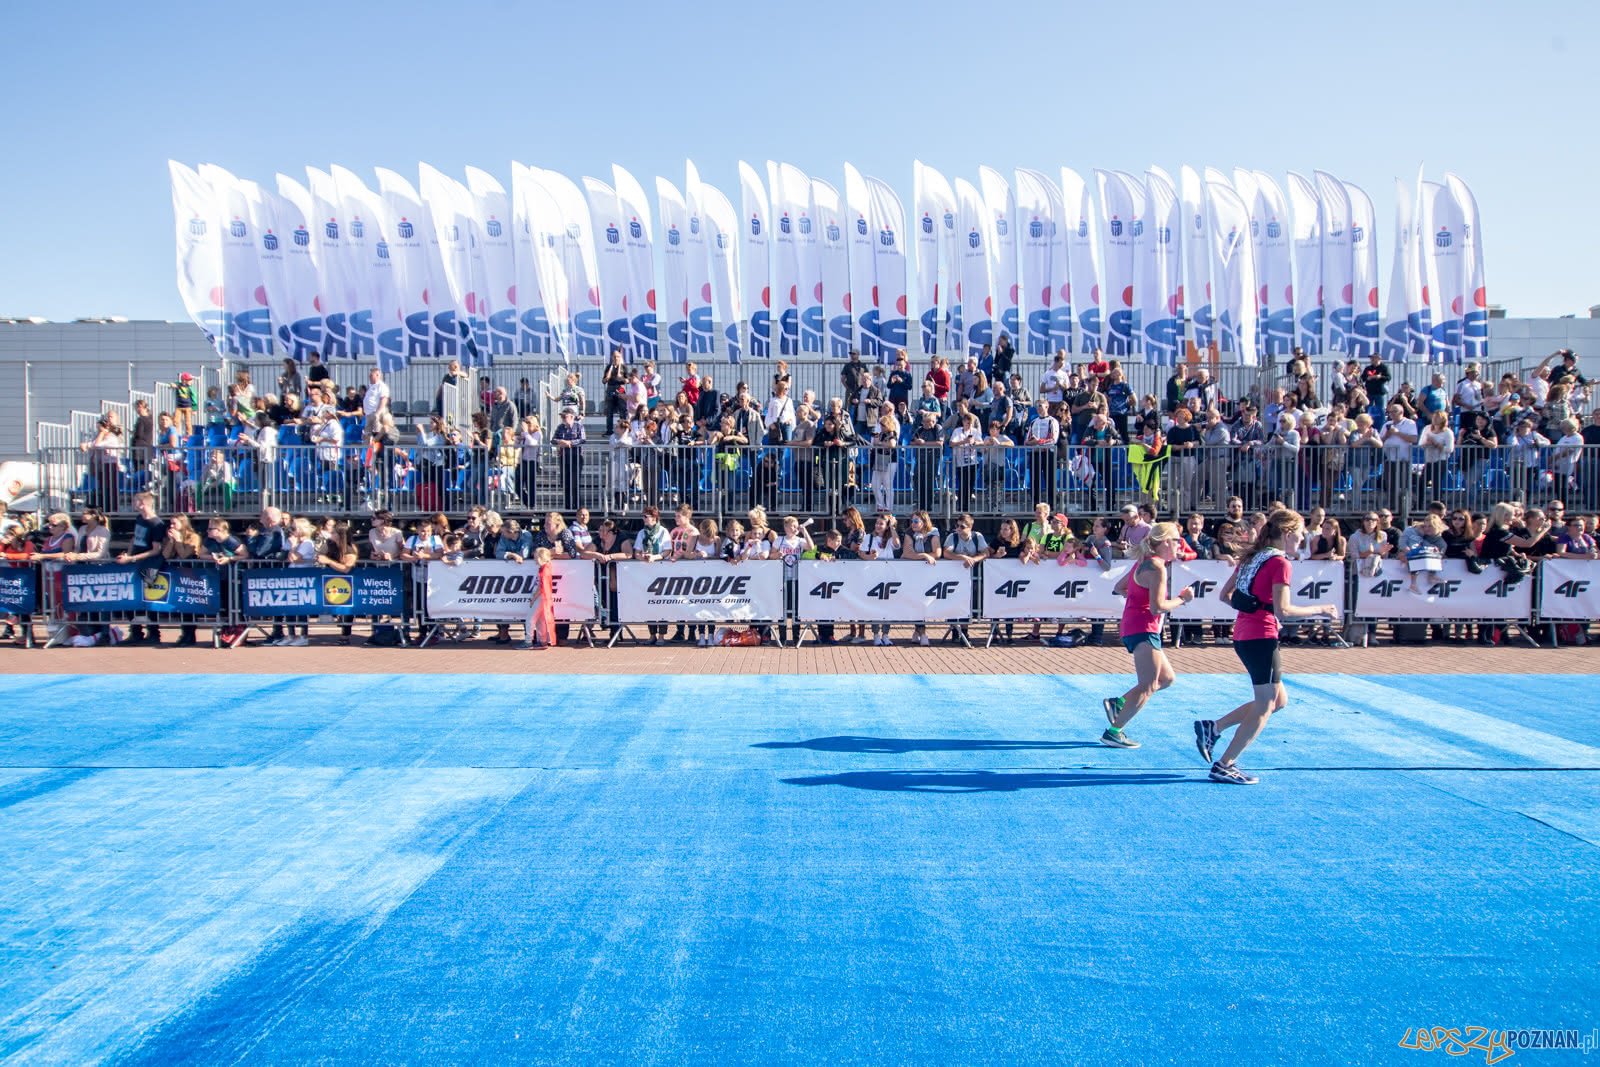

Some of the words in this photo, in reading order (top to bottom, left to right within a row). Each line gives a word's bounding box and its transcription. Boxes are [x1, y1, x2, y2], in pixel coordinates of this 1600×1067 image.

[67, 572, 135, 586] BIEGNIEMY
[180, 577, 207, 589] Więcej
[248, 577, 316, 590] BIEGNIEMY
[363, 578, 391, 589] Więcej
[647, 576, 751, 596] 4MOVE
[68, 584, 134, 603] RAZEM
[187, 586, 213, 596] radość
[370, 587, 397, 596] radość
[809, 581, 844, 599] 4F
[866, 581, 902, 600] 4F
[924, 581, 959, 599] 4F
[994, 579, 1031, 598] 4F
[1053, 580, 1089, 598] 4F
[1297, 581, 1332, 599] 4F
[1369, 580, 1403, 597] 4F
[1427, 580, 1461, 598] 4F
[1554, 580, 1590, 598] 4F
[185, 595, 209, 605] życia!
[248, 589, 317, 607] RAZEM
[369, 596, 393, 606] życia!
